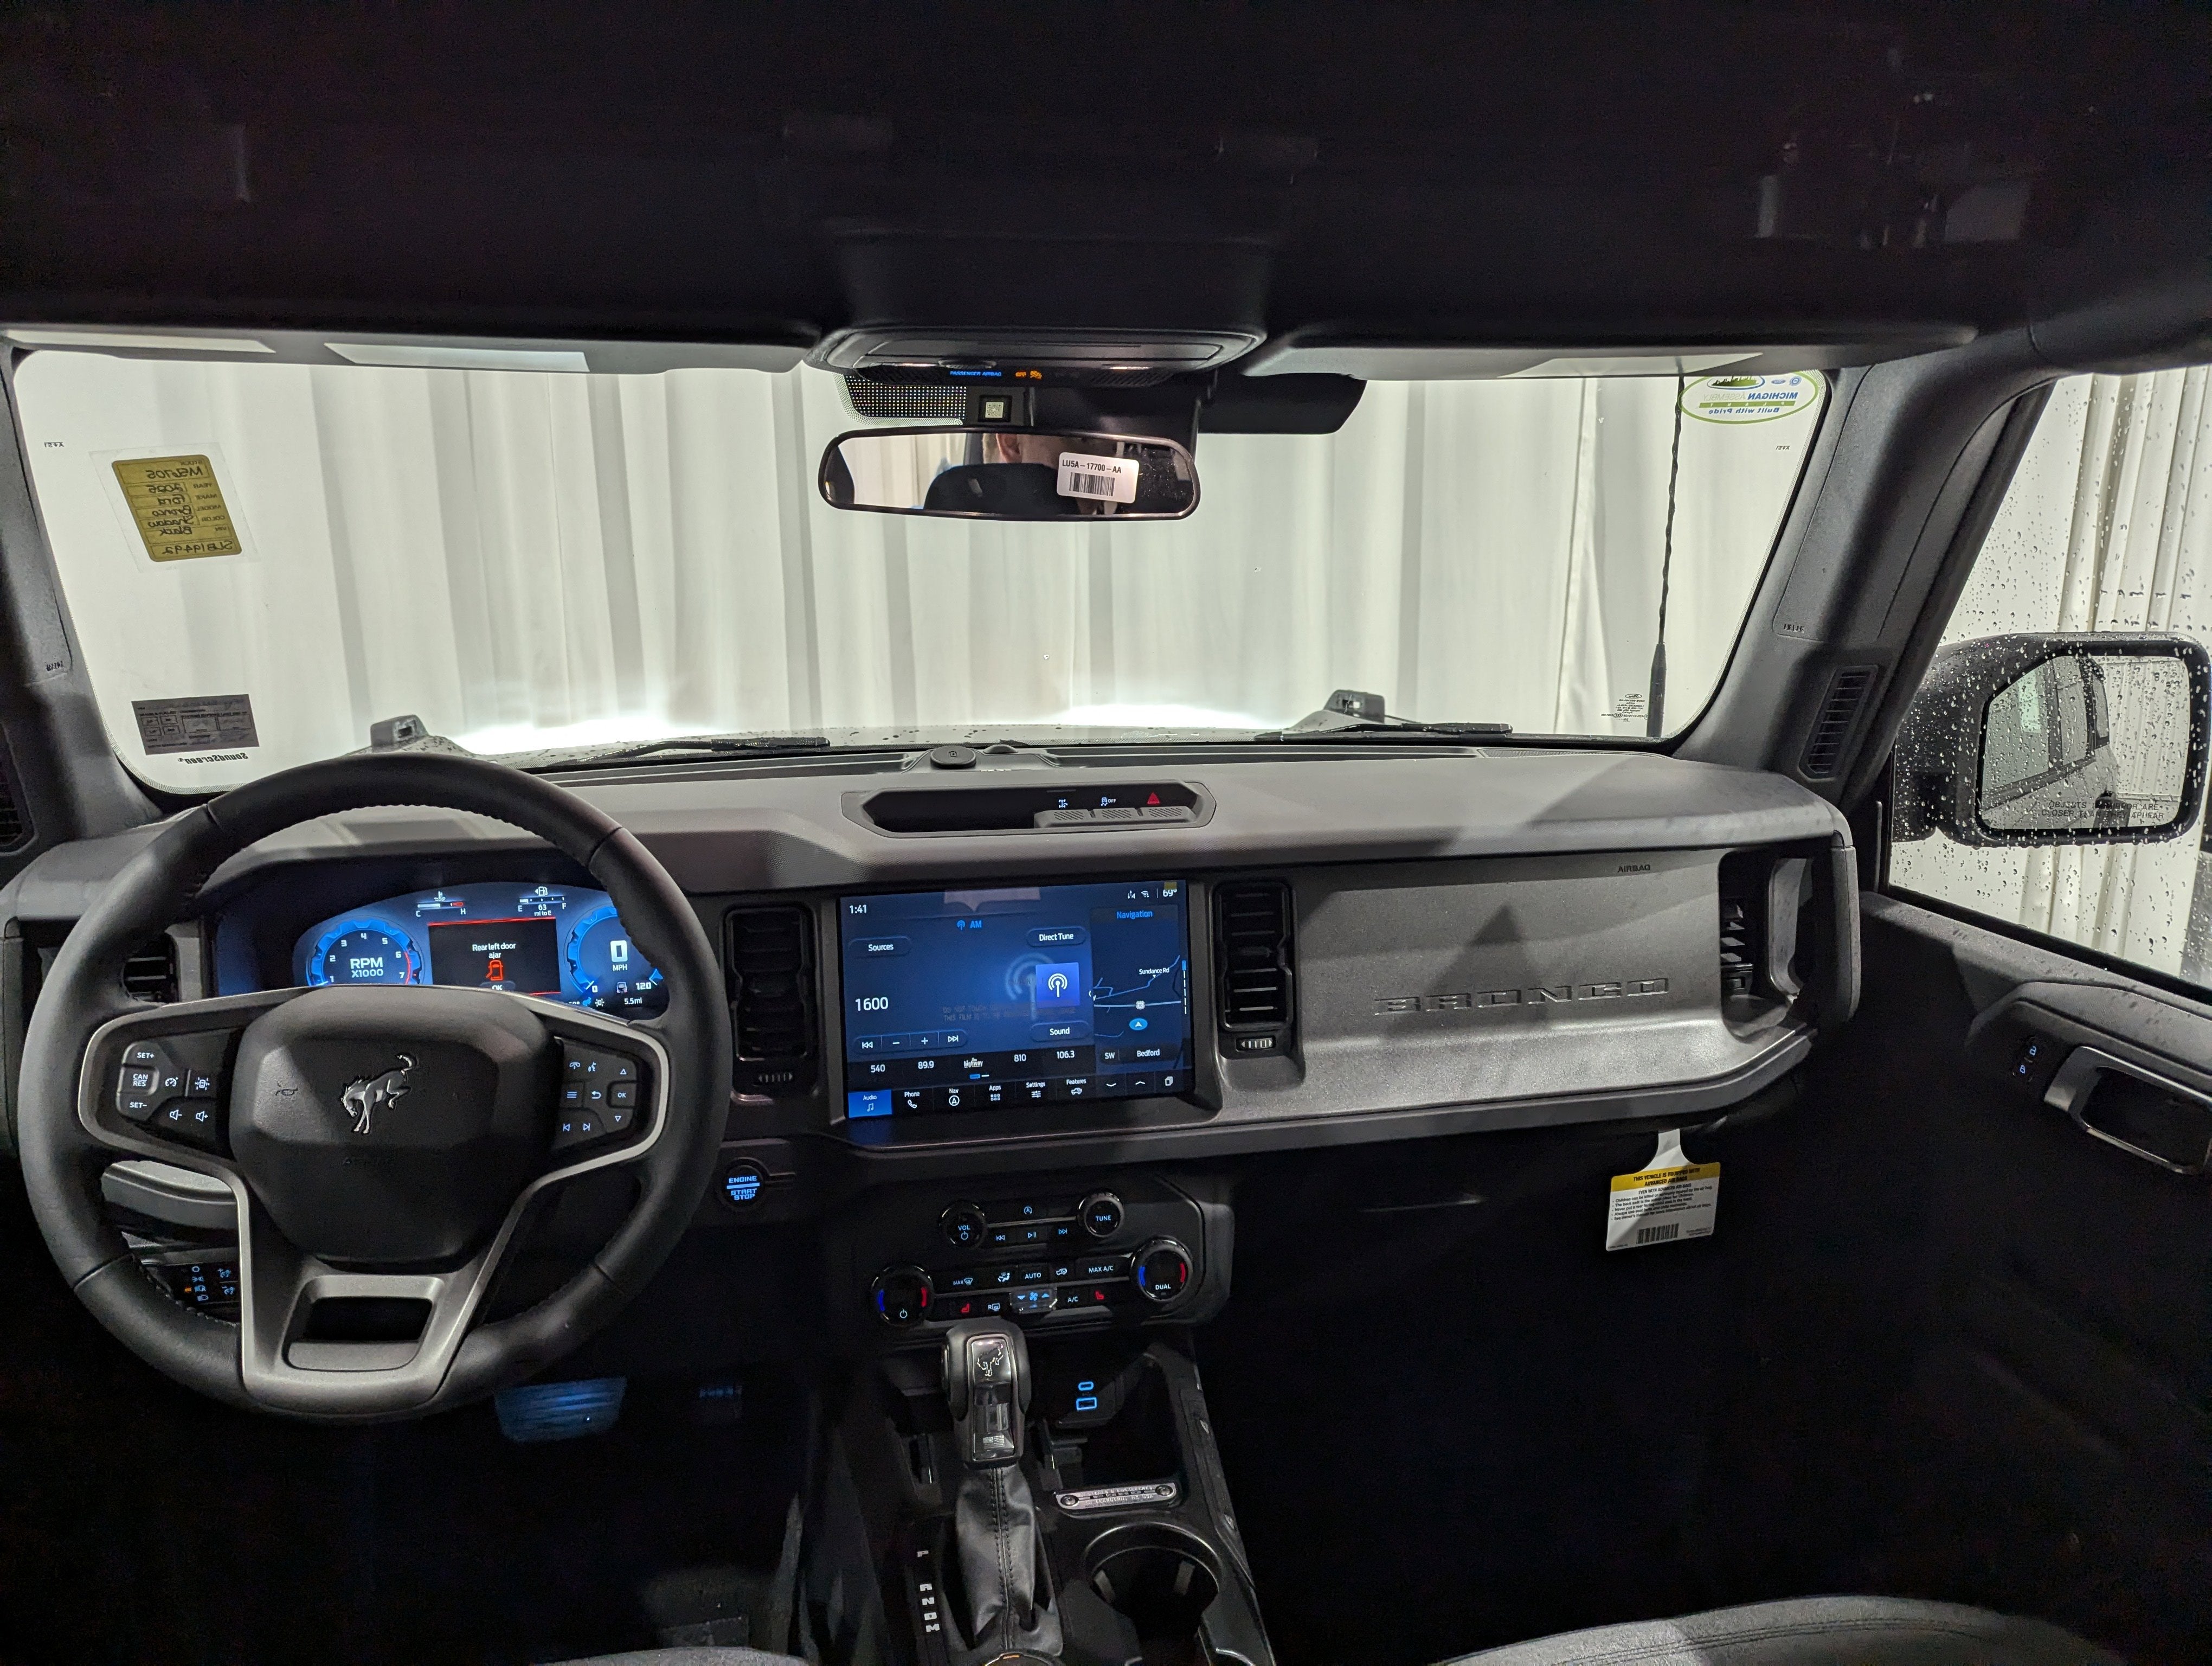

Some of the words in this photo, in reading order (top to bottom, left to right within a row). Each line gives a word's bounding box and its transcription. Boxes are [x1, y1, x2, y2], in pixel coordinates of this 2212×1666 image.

[2049, 801, 2087, 809] OBJECTS
[1617, 864, 1650, 873] AIRBAG
[850, 905, 867, 913] 1:41
[1116, 911, 1153, 920] Navigation
[970, 920, 982, 928] AM
[610, 940, 628, 962] 0
[350, 957, 383, 969] RPM
[351, 969, 383, 978] X1000
[1374, 978, 1669, 1016] BRONCO
[856, 997, 889, 1011] 1600
[1050, 1027, 1070, 1036] Sound
[1014, 1054, 1026, 1062] 810
[1057, 1050, 1075, 1059] 106.3
[1136, 1049, 1160, 1058] Bedford
[871, 1064, 885, 1073] 540
[918, 1061, 934, 1069] 89.9
[964, 1060, 983, 1068] highway
[922, 1597, 934, 1605] N
[926, 1624, 940, 1632] M
